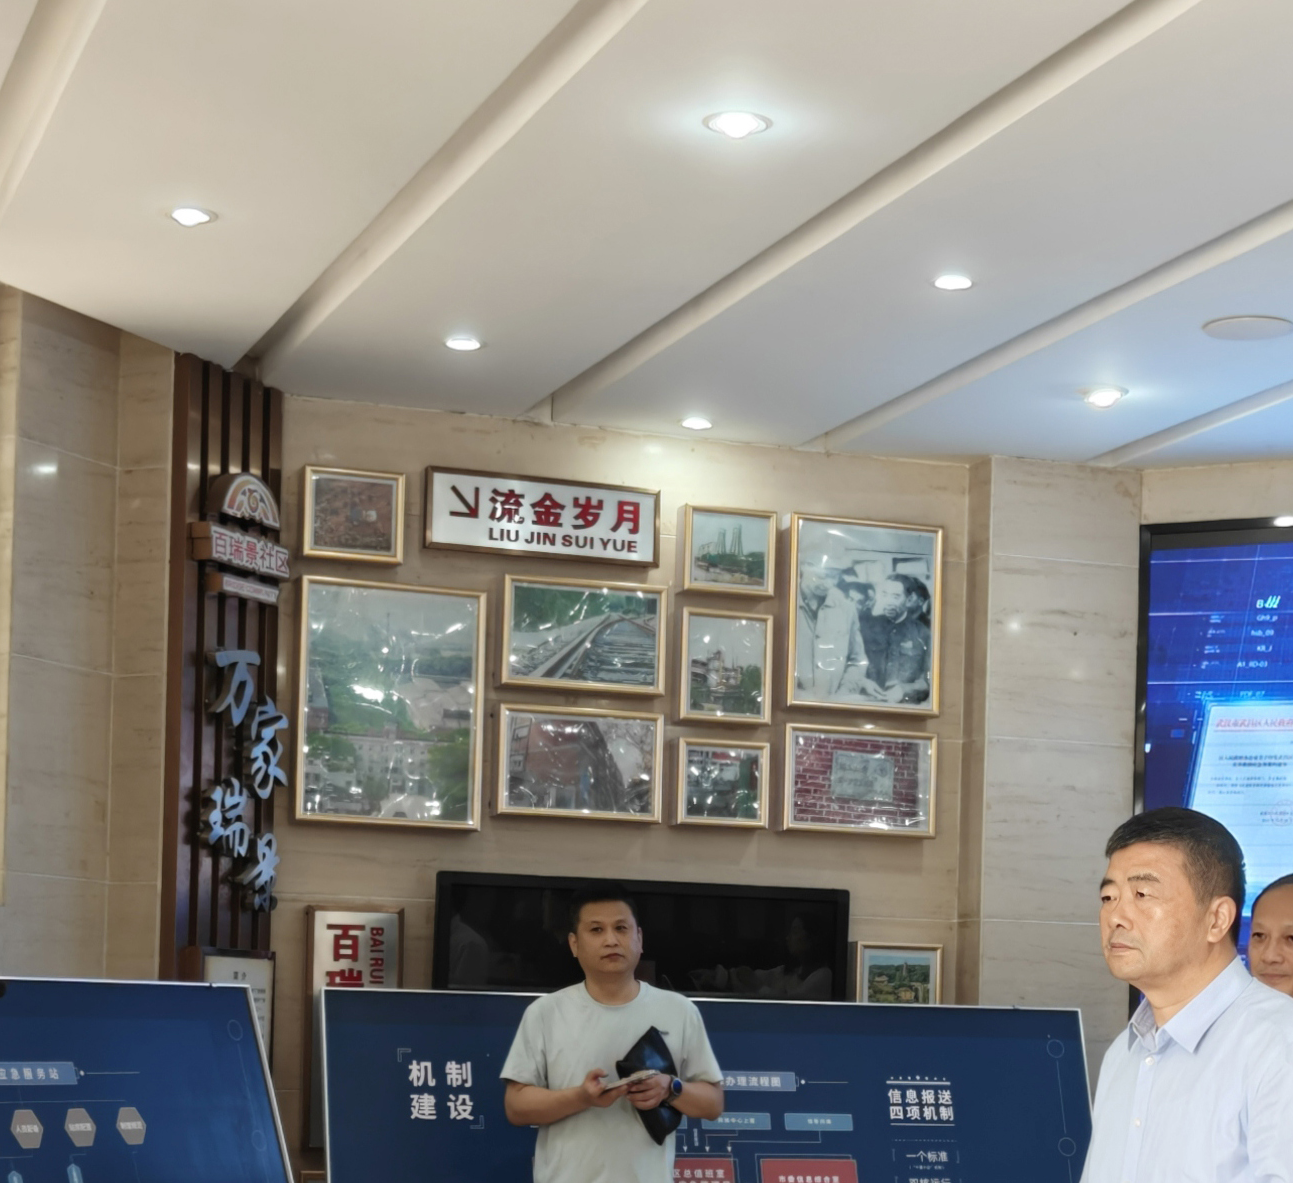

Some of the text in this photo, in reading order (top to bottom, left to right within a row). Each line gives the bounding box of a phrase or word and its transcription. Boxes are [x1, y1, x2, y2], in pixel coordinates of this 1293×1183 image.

[488, 487, 641, 535] 流金岁月
[212, 529, 289, 575] 百瑞景社区
[488, 527, 639, 553] LIU JIN SUI YUE
[369, 927, 384, 985] BAI RUI
[409, 1061, 473, 1088] 机制
[721, 1076, 782, 1088] 办理流程图
[410, 1094, 475, 1121] 建设
[888, 1088, 953, 1105] 信息报送
[889, 1105, 955, 1121] 四项机制
[905, 1150, 949, 1163] 一个标准
